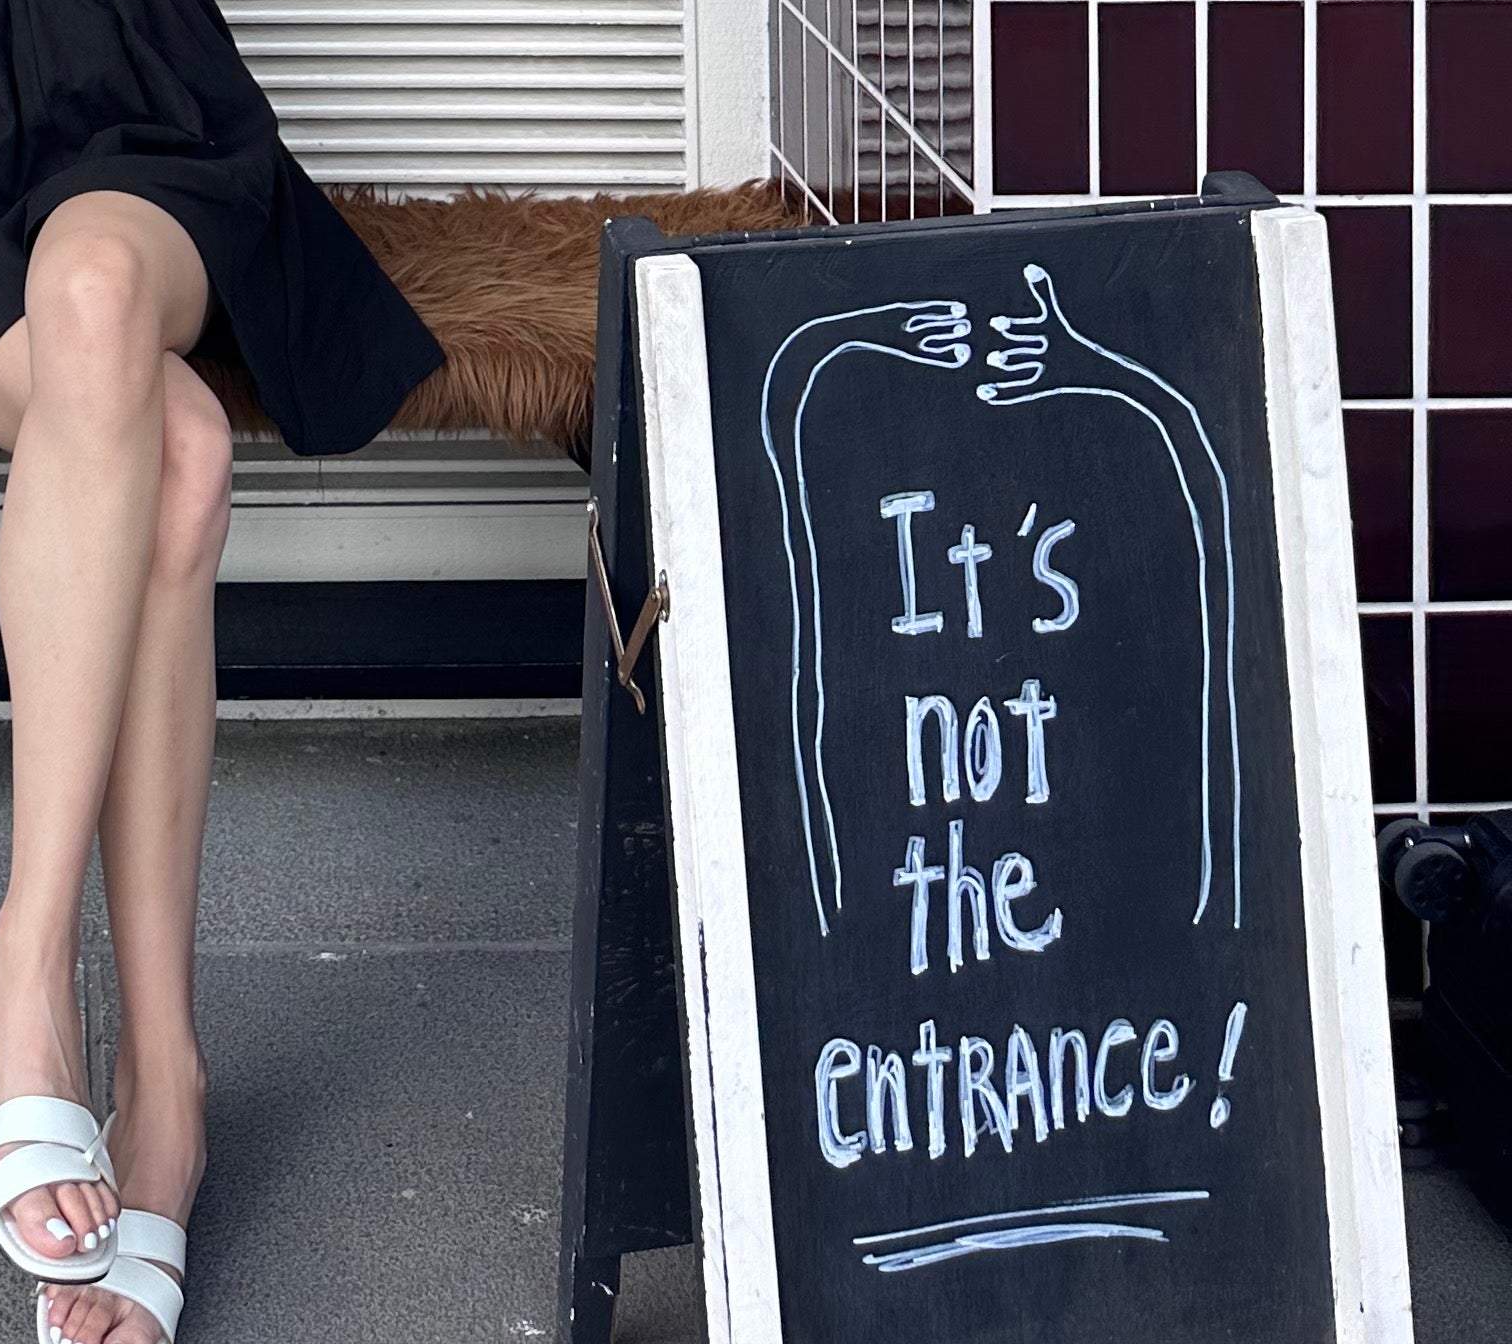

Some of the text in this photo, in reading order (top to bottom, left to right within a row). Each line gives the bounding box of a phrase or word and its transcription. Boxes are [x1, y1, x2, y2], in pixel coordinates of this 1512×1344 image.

[880, 490, 1080, 638] It's
[905, 678, 1058, 805] not
[893, 819, 1063, 974] the
